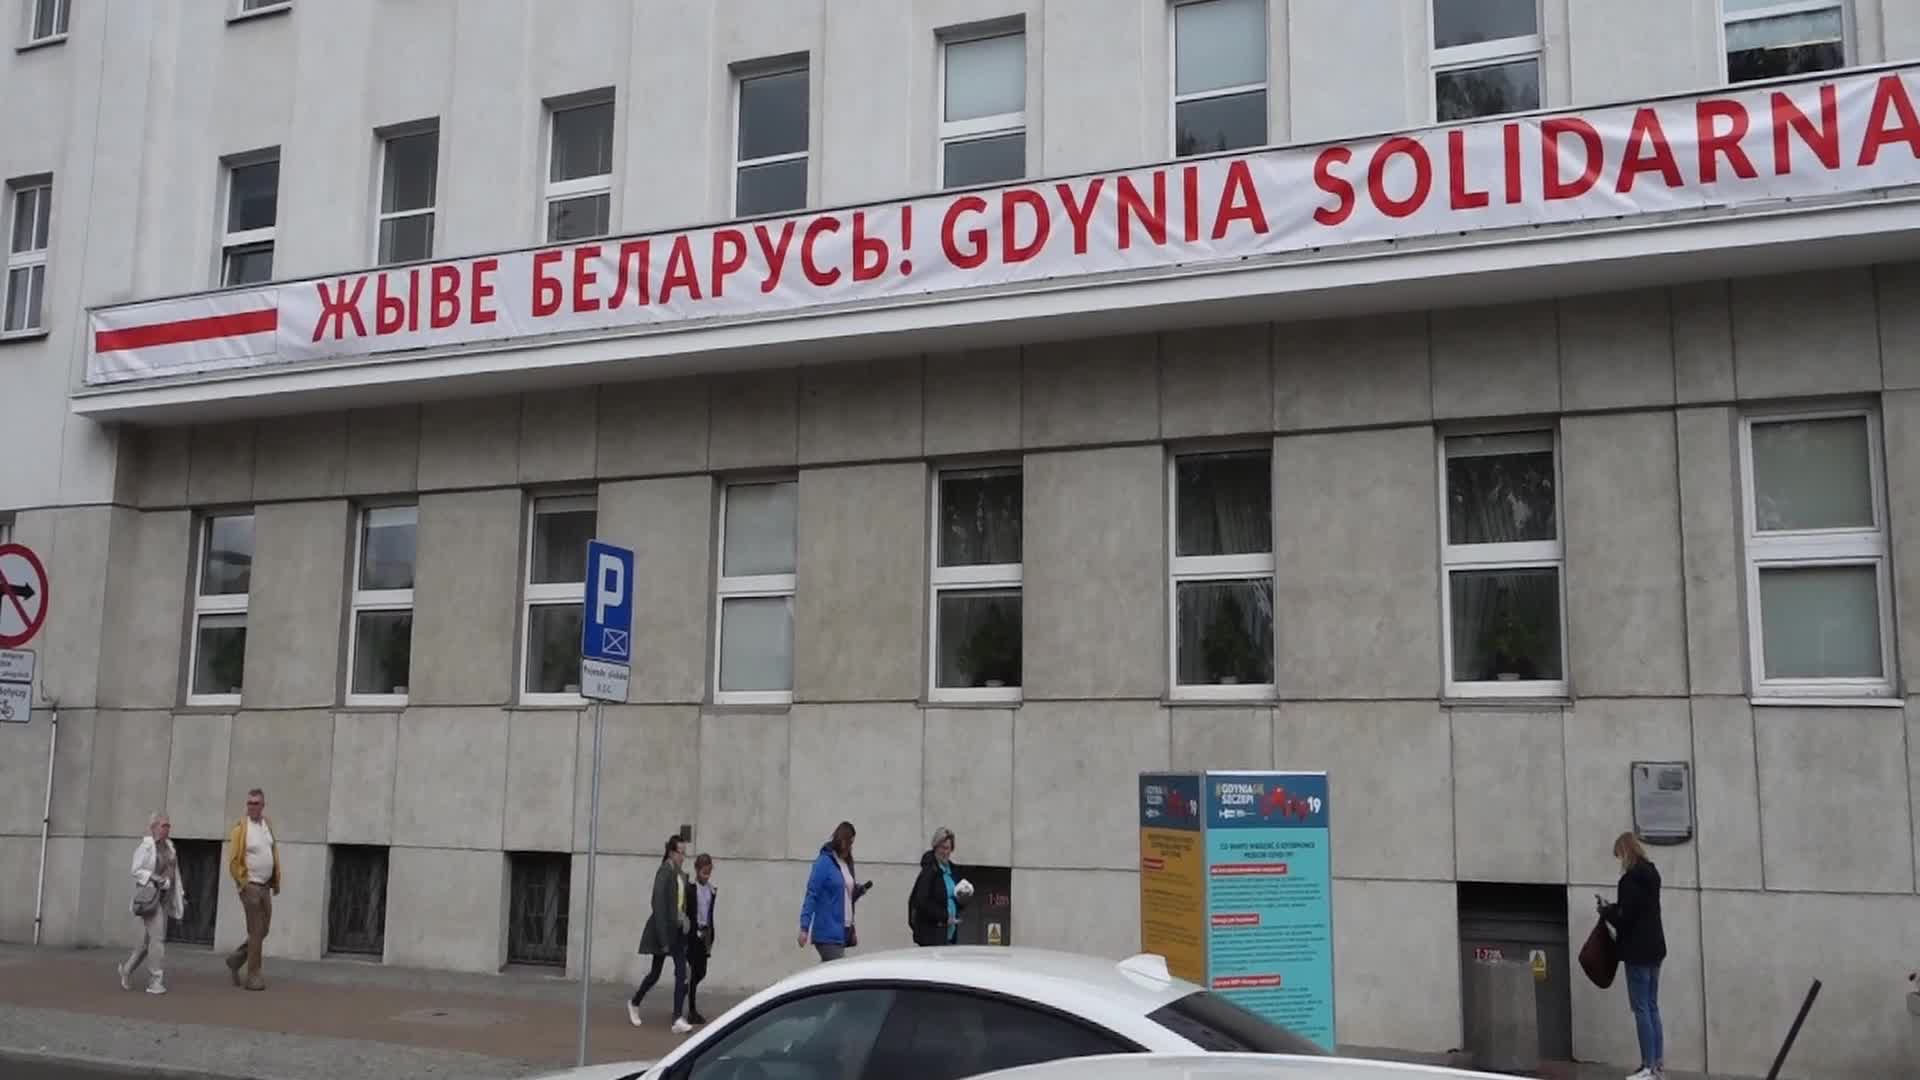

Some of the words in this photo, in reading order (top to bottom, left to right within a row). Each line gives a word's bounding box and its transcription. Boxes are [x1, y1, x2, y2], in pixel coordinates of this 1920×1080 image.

[942, 160, 1268, 269] GDYNIA
[1313, 77, 1920, 226] SOLIDARNA
[315, 260, 498, 339] ЖЫВЕ
[532, 207, 913, 317] БЕЛАРУСЬ!
[596, 553, 624, 625] P
[1307, 796, 1321, 813] 19
